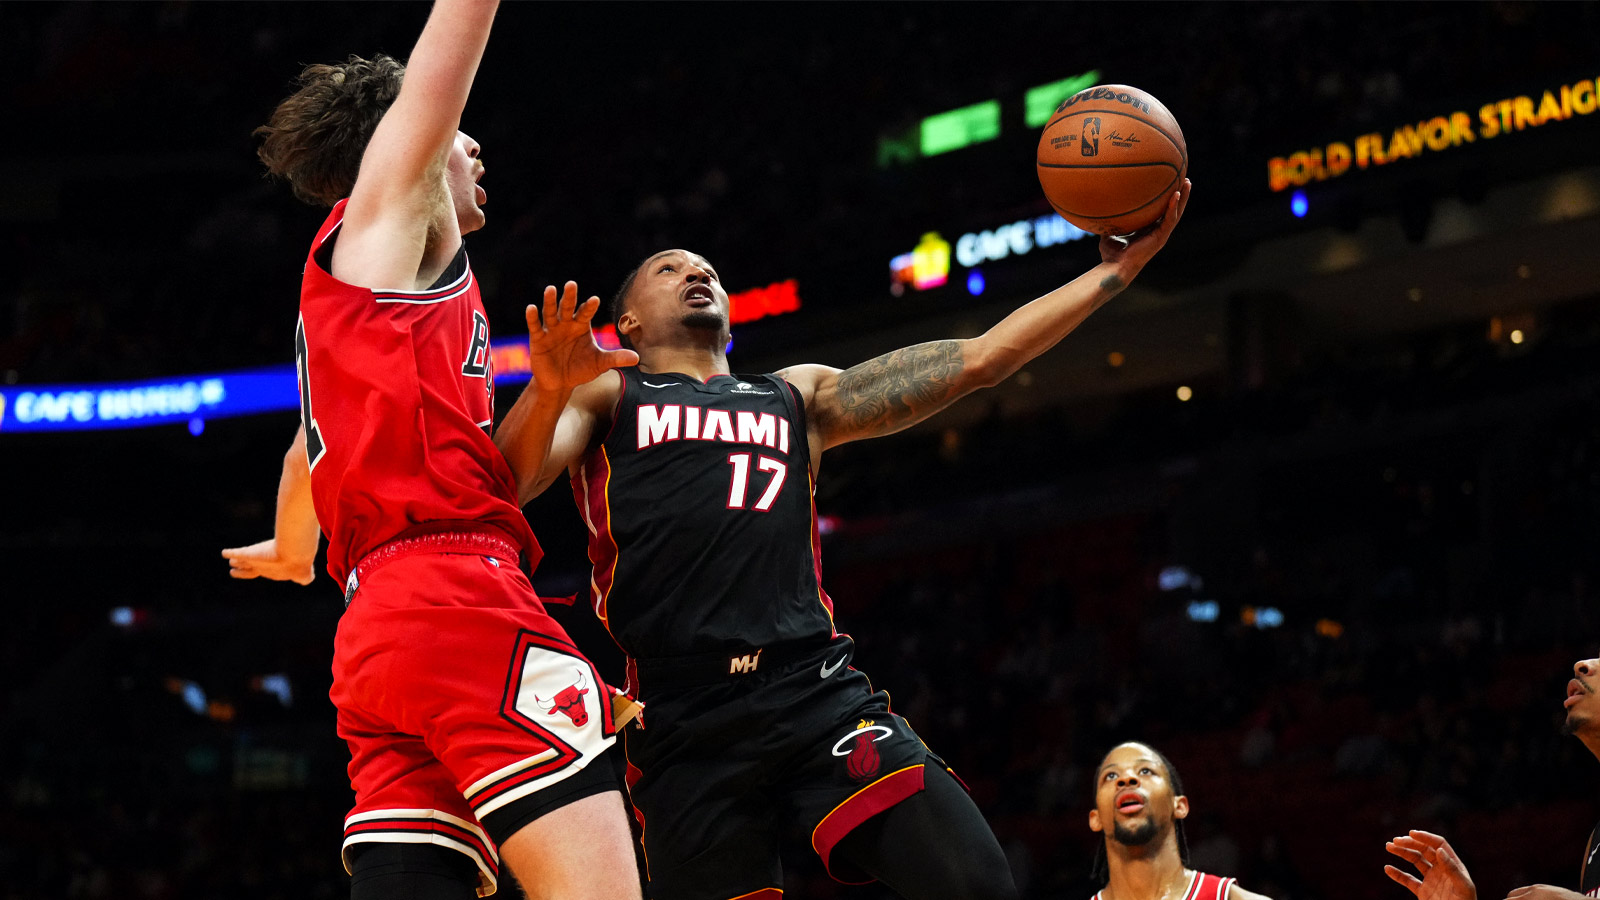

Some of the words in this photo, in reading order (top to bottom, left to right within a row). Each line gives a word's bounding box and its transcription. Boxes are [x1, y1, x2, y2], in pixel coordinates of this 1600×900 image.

[1268, 141, 1351, 192] BOLD
[1355, 111, 1476, 168] FLAVOR
[1479, 76, 1600, 138] STRAIG
[637, 404, 790, 455] MIAMI
[726, 452, 788, 512] 17
